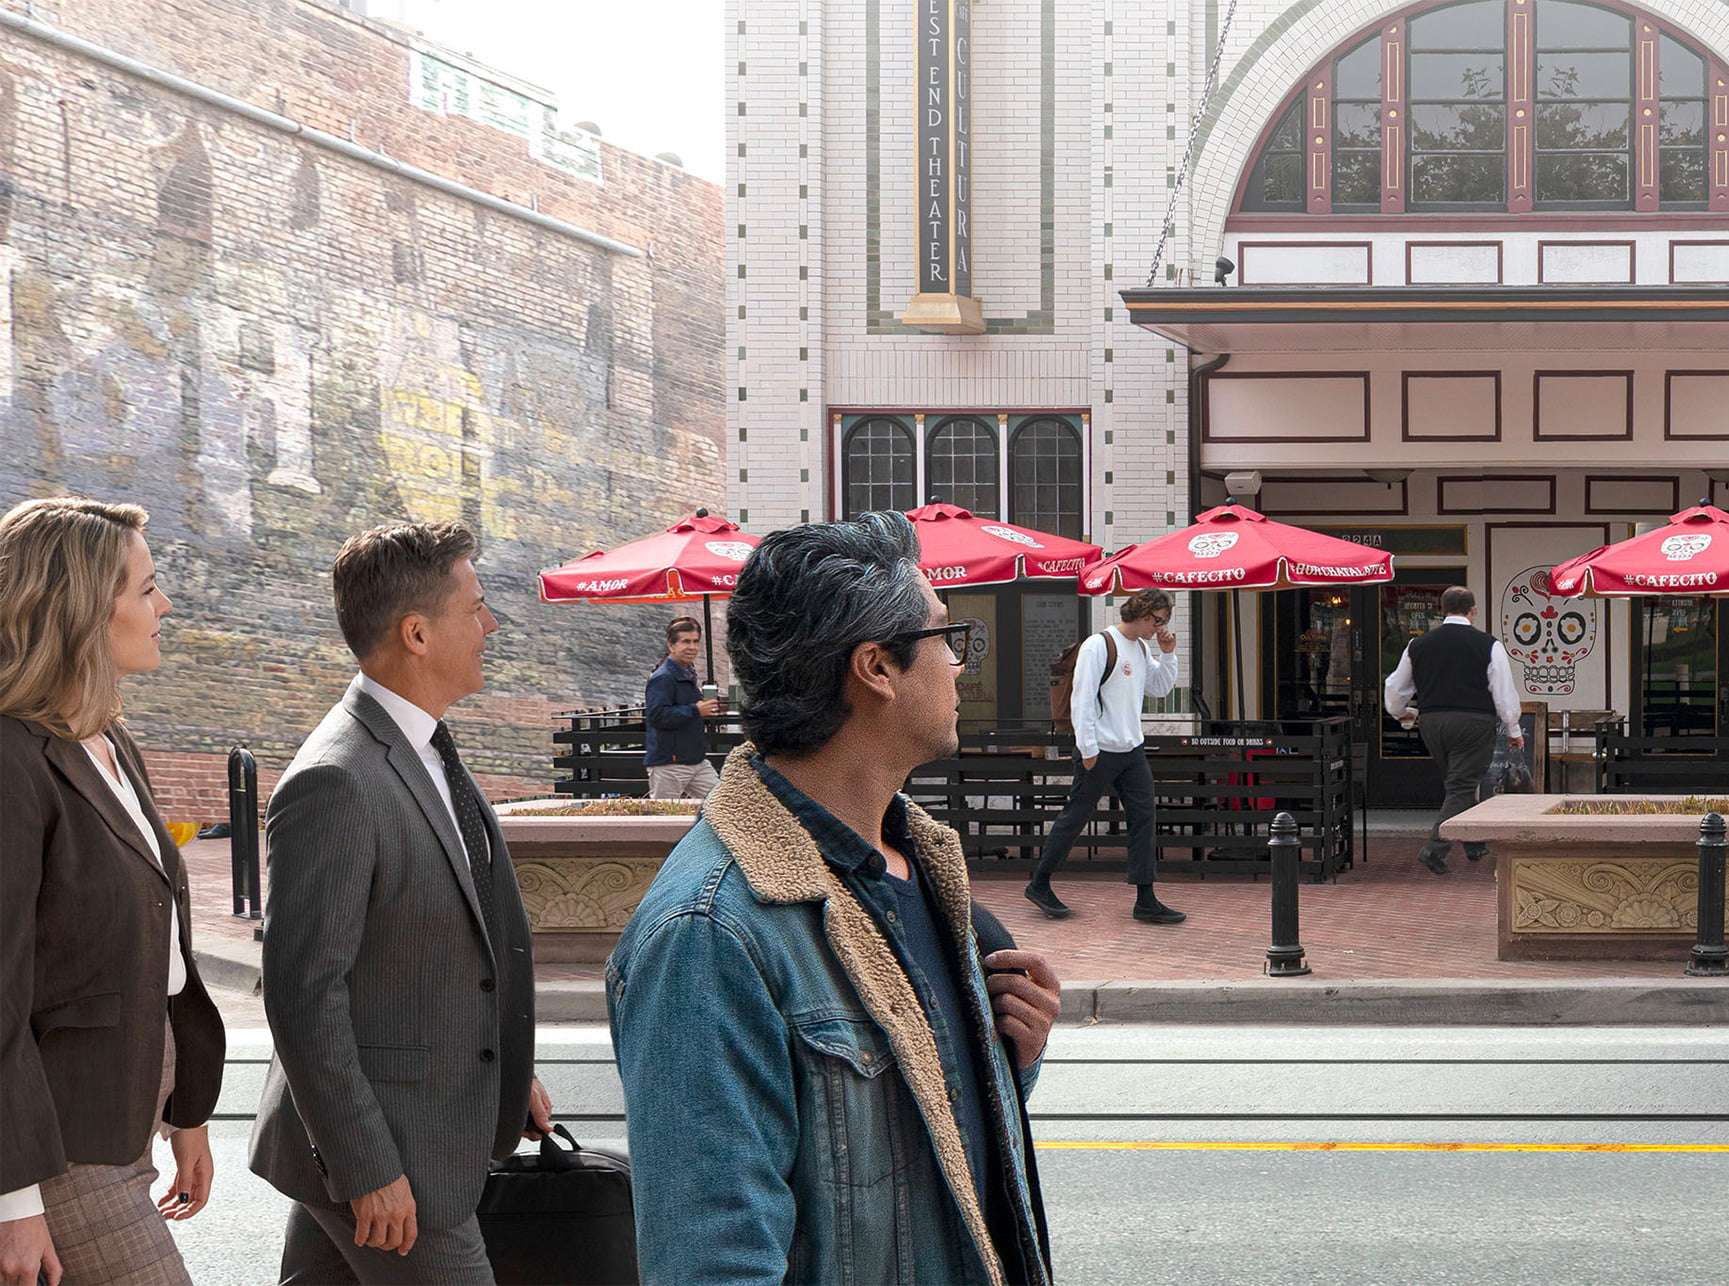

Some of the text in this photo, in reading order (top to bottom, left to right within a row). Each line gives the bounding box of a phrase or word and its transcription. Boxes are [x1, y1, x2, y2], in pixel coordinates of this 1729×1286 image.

[928, 66, 942, 127] END
[957, 37, 968, 273] CULTURA
[928, 136, 947, 281] THEATER
[926, 565, 967, 581] MOR
[1152, 567, 1246, 584] #CAFECITO
[1623, 571, 1718, 588] #CAFECITO
[575, 578, 630, 592] #AMOR
